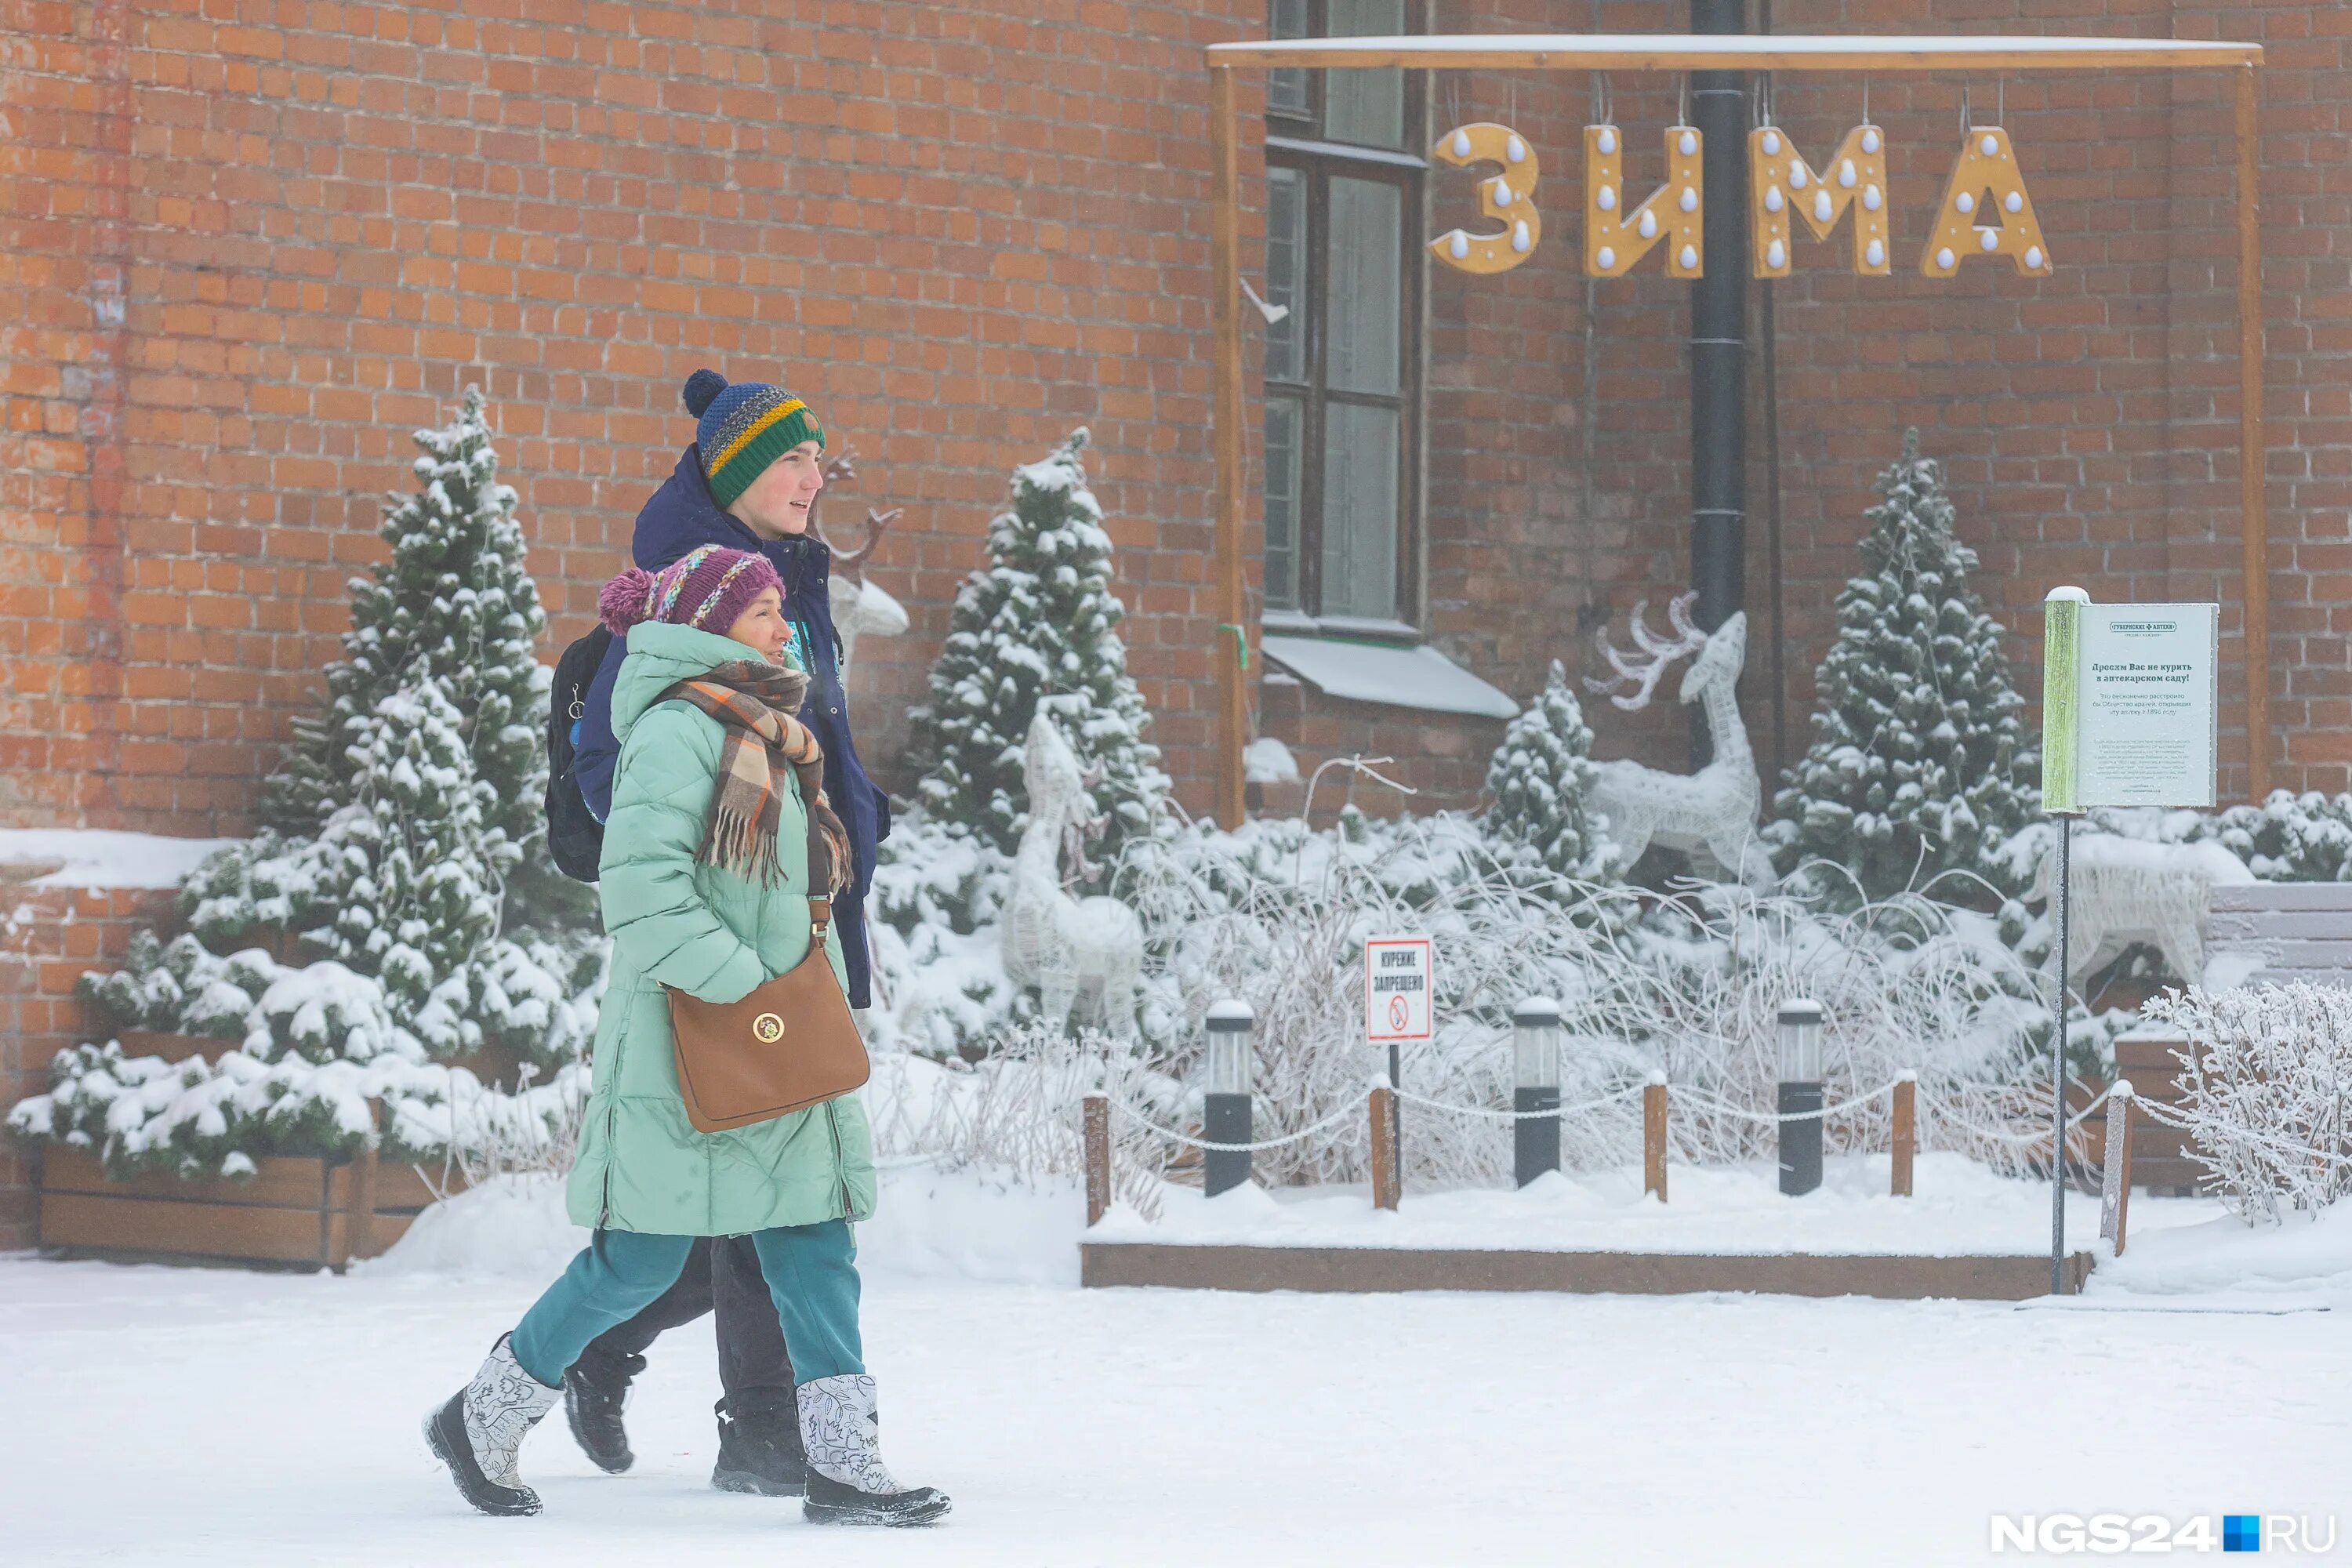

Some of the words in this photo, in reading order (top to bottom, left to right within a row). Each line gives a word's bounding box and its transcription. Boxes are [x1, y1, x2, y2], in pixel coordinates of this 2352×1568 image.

[1427, 122, 2053, 279] ЗИМА
[2160, 664, 2192, 673] курить
[2103, 675, 2163, 684] аптекарском
[2165, 674, 2190, 684] саду!
[1381, 951, 1416, 967] КУРЕНИЕ
[1374, 975, 1424, 992] ЗАПРЕЩЕНО
